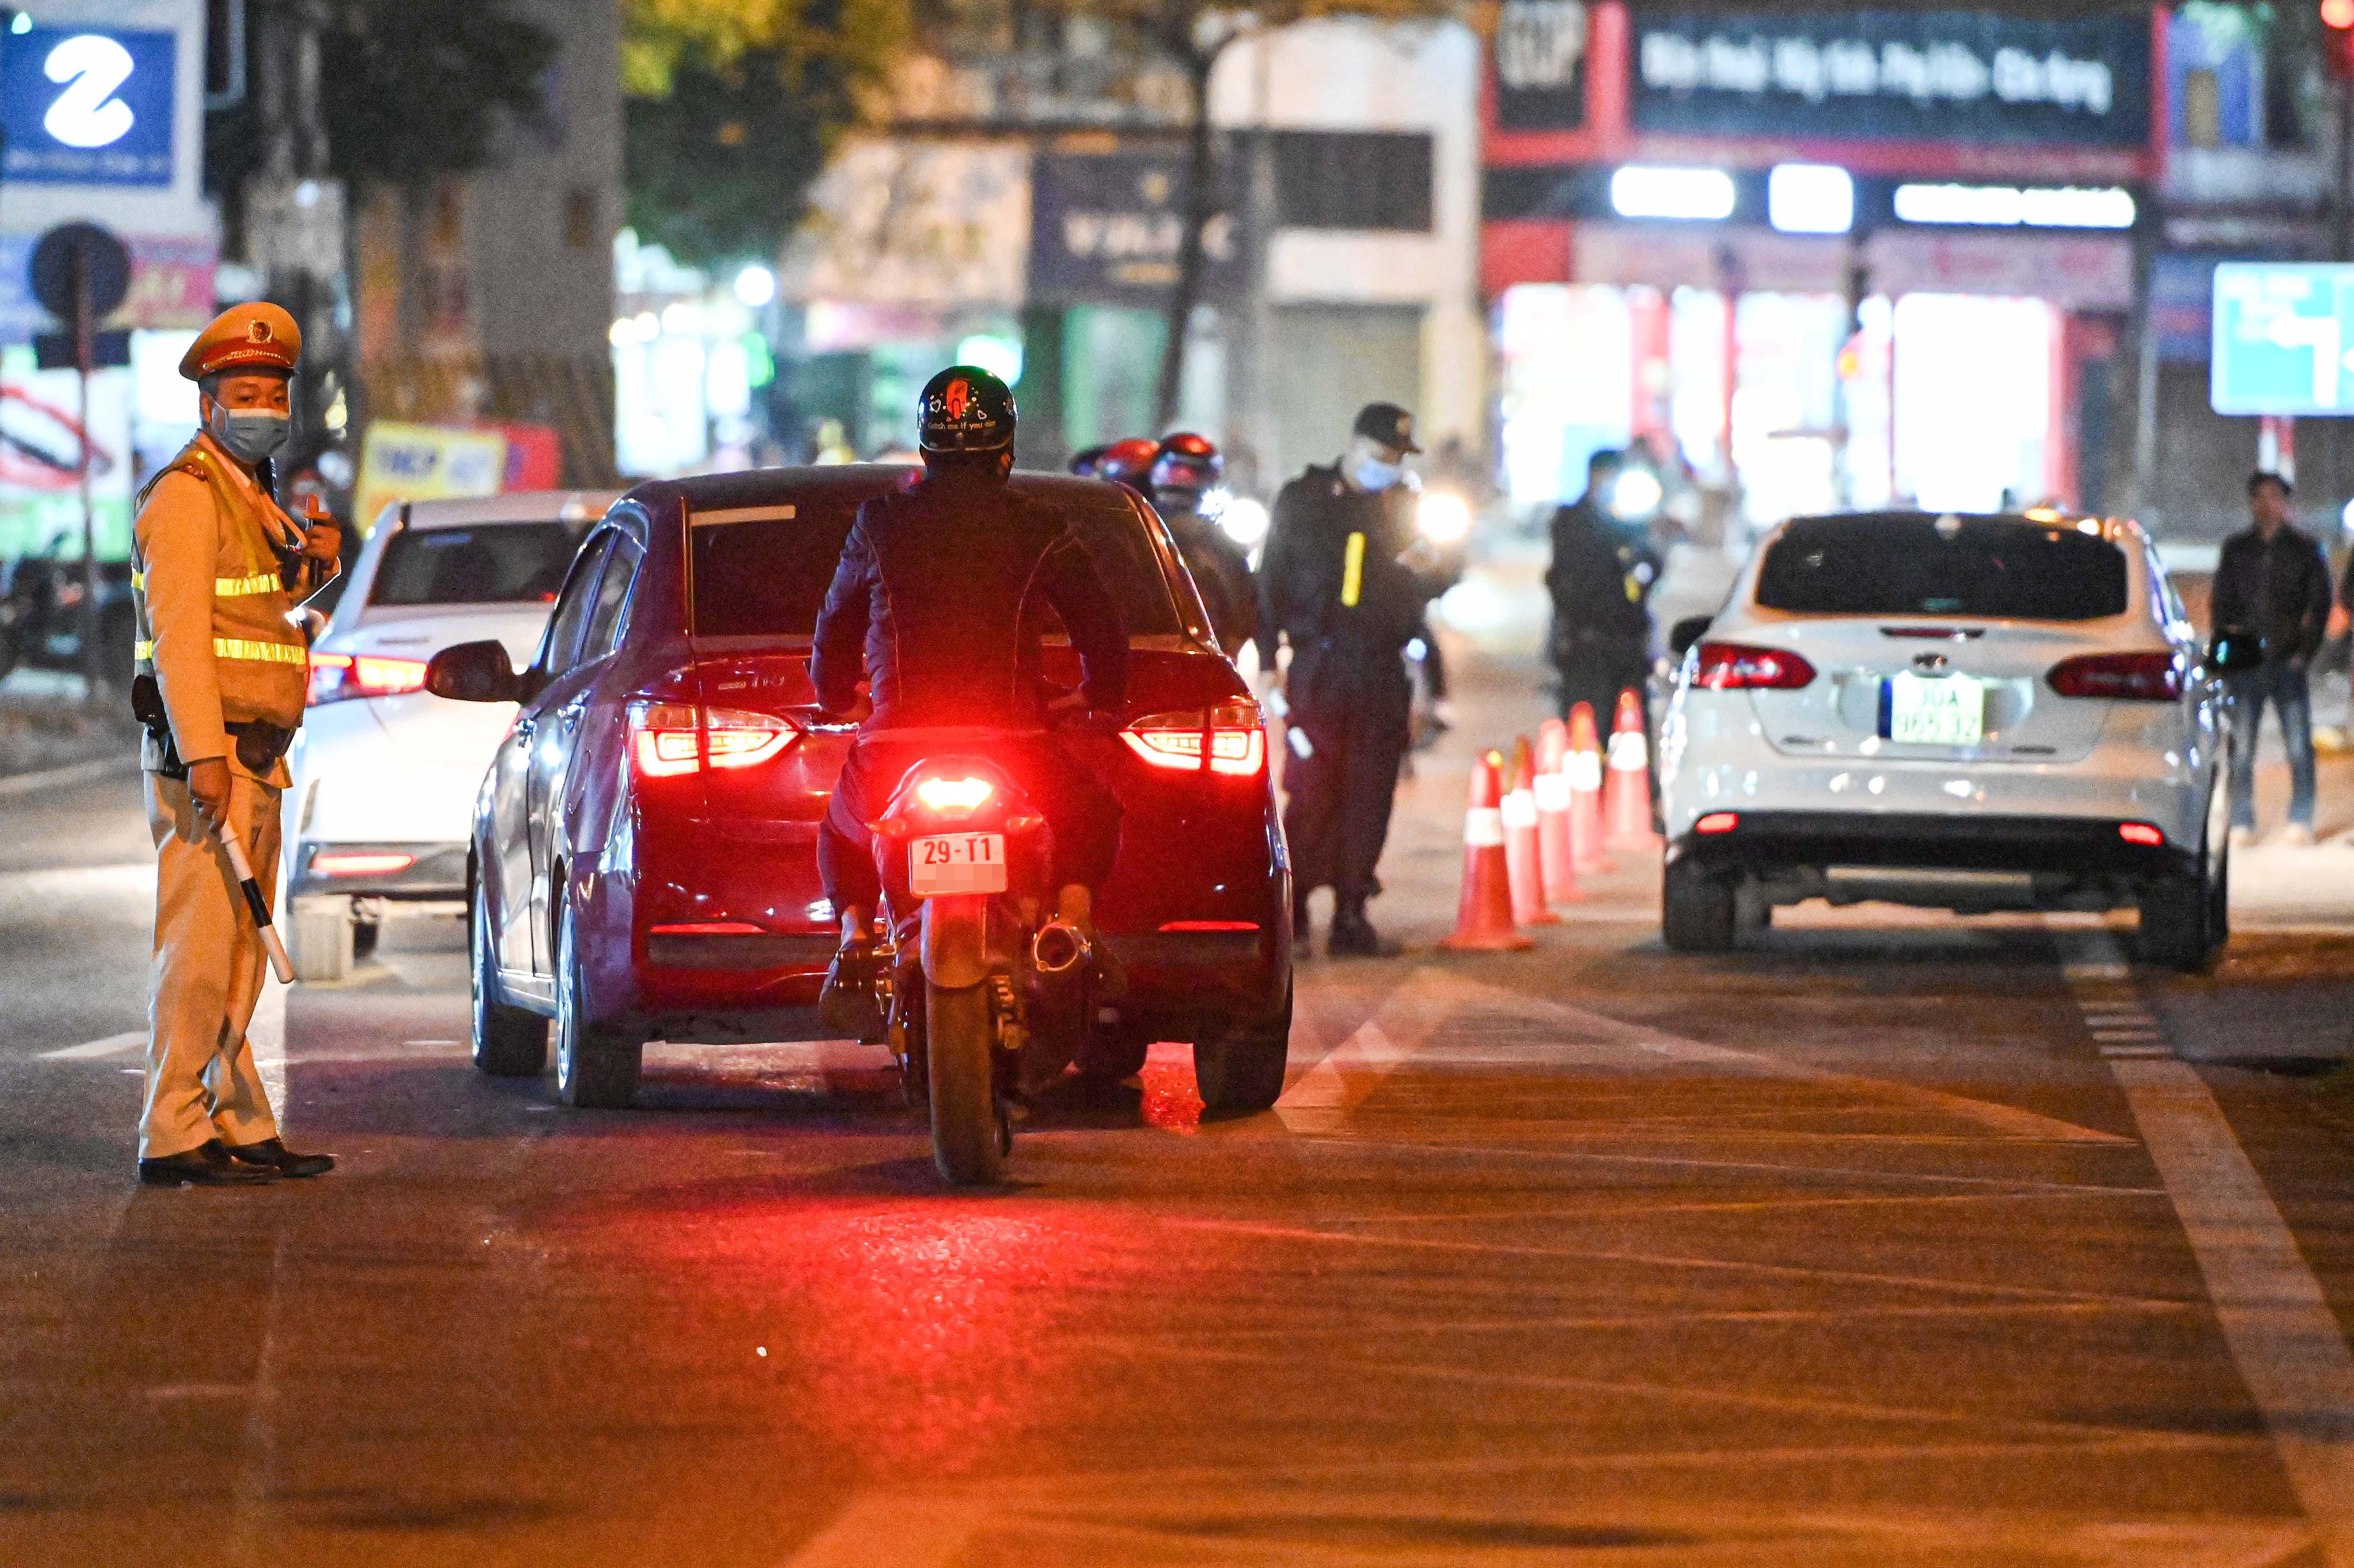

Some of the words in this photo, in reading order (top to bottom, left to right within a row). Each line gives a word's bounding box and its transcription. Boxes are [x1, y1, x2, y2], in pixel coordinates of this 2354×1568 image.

[960, 422, 967, 430] if
[969, 422, 983, 431] you
[923, 837, 991, 865] 29-T1
